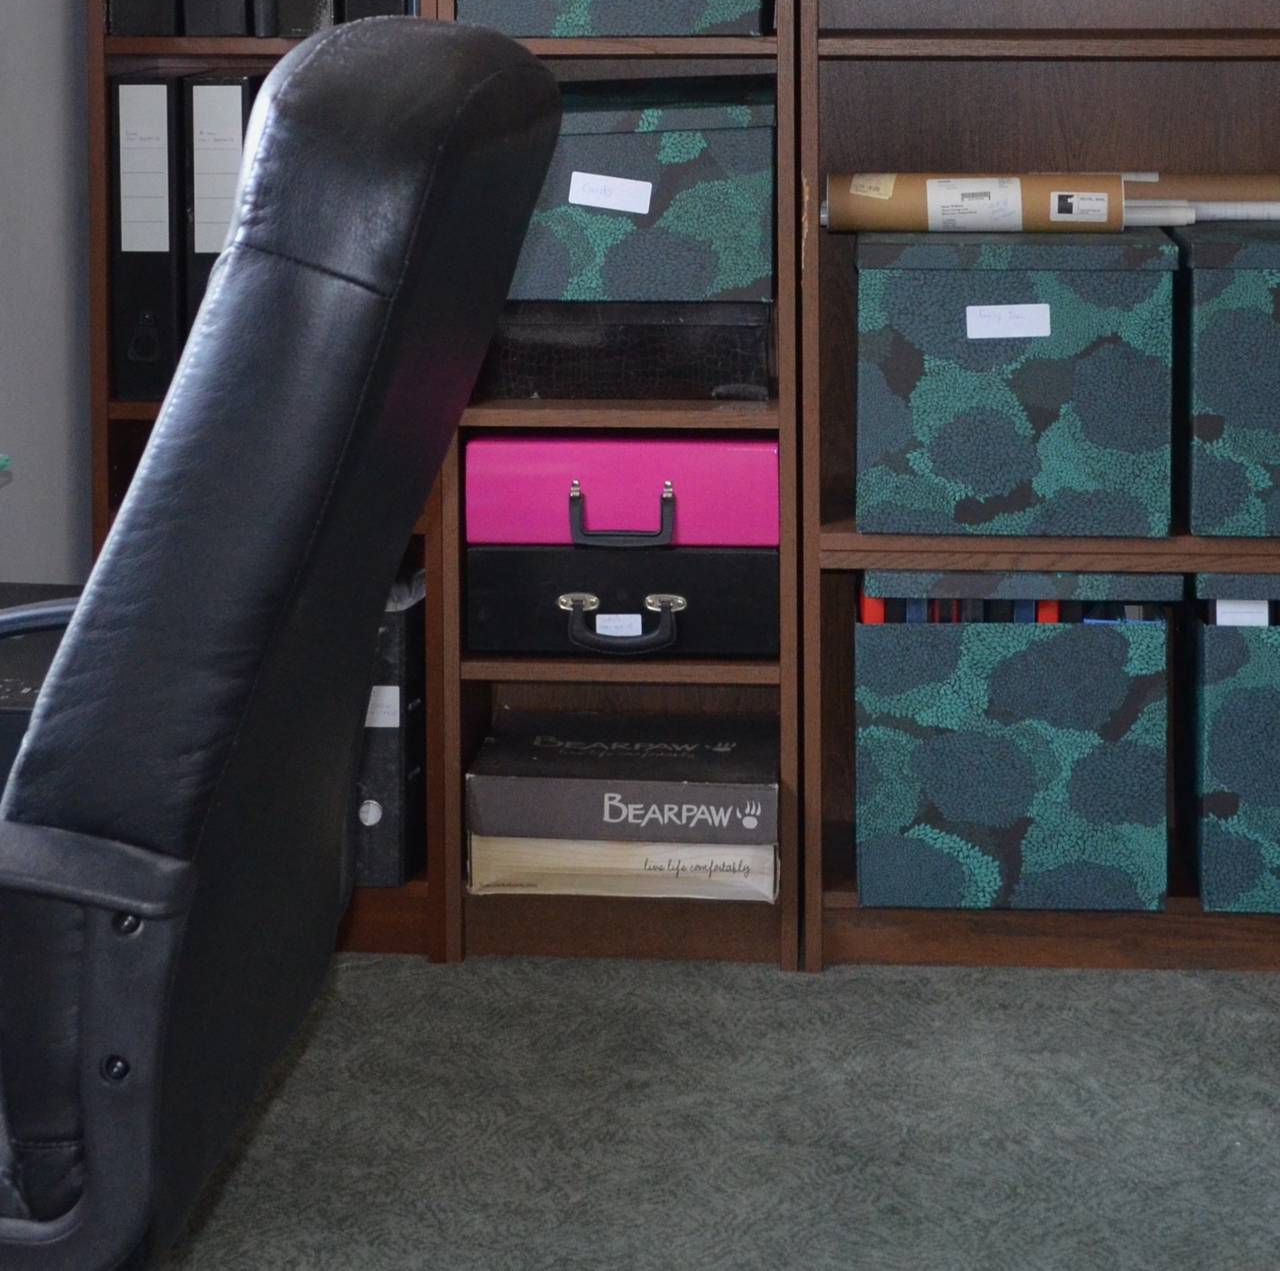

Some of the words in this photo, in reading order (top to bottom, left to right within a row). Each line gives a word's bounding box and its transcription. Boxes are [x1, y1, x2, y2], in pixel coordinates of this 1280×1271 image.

[532, 735, 700, 752] BEARPAW
[602, 792, 734, 829] BEARPAW
[643, 858, 665, 872] live
[666, 859, 688, 878] life
[689, 858, 752, 878] comfortably
